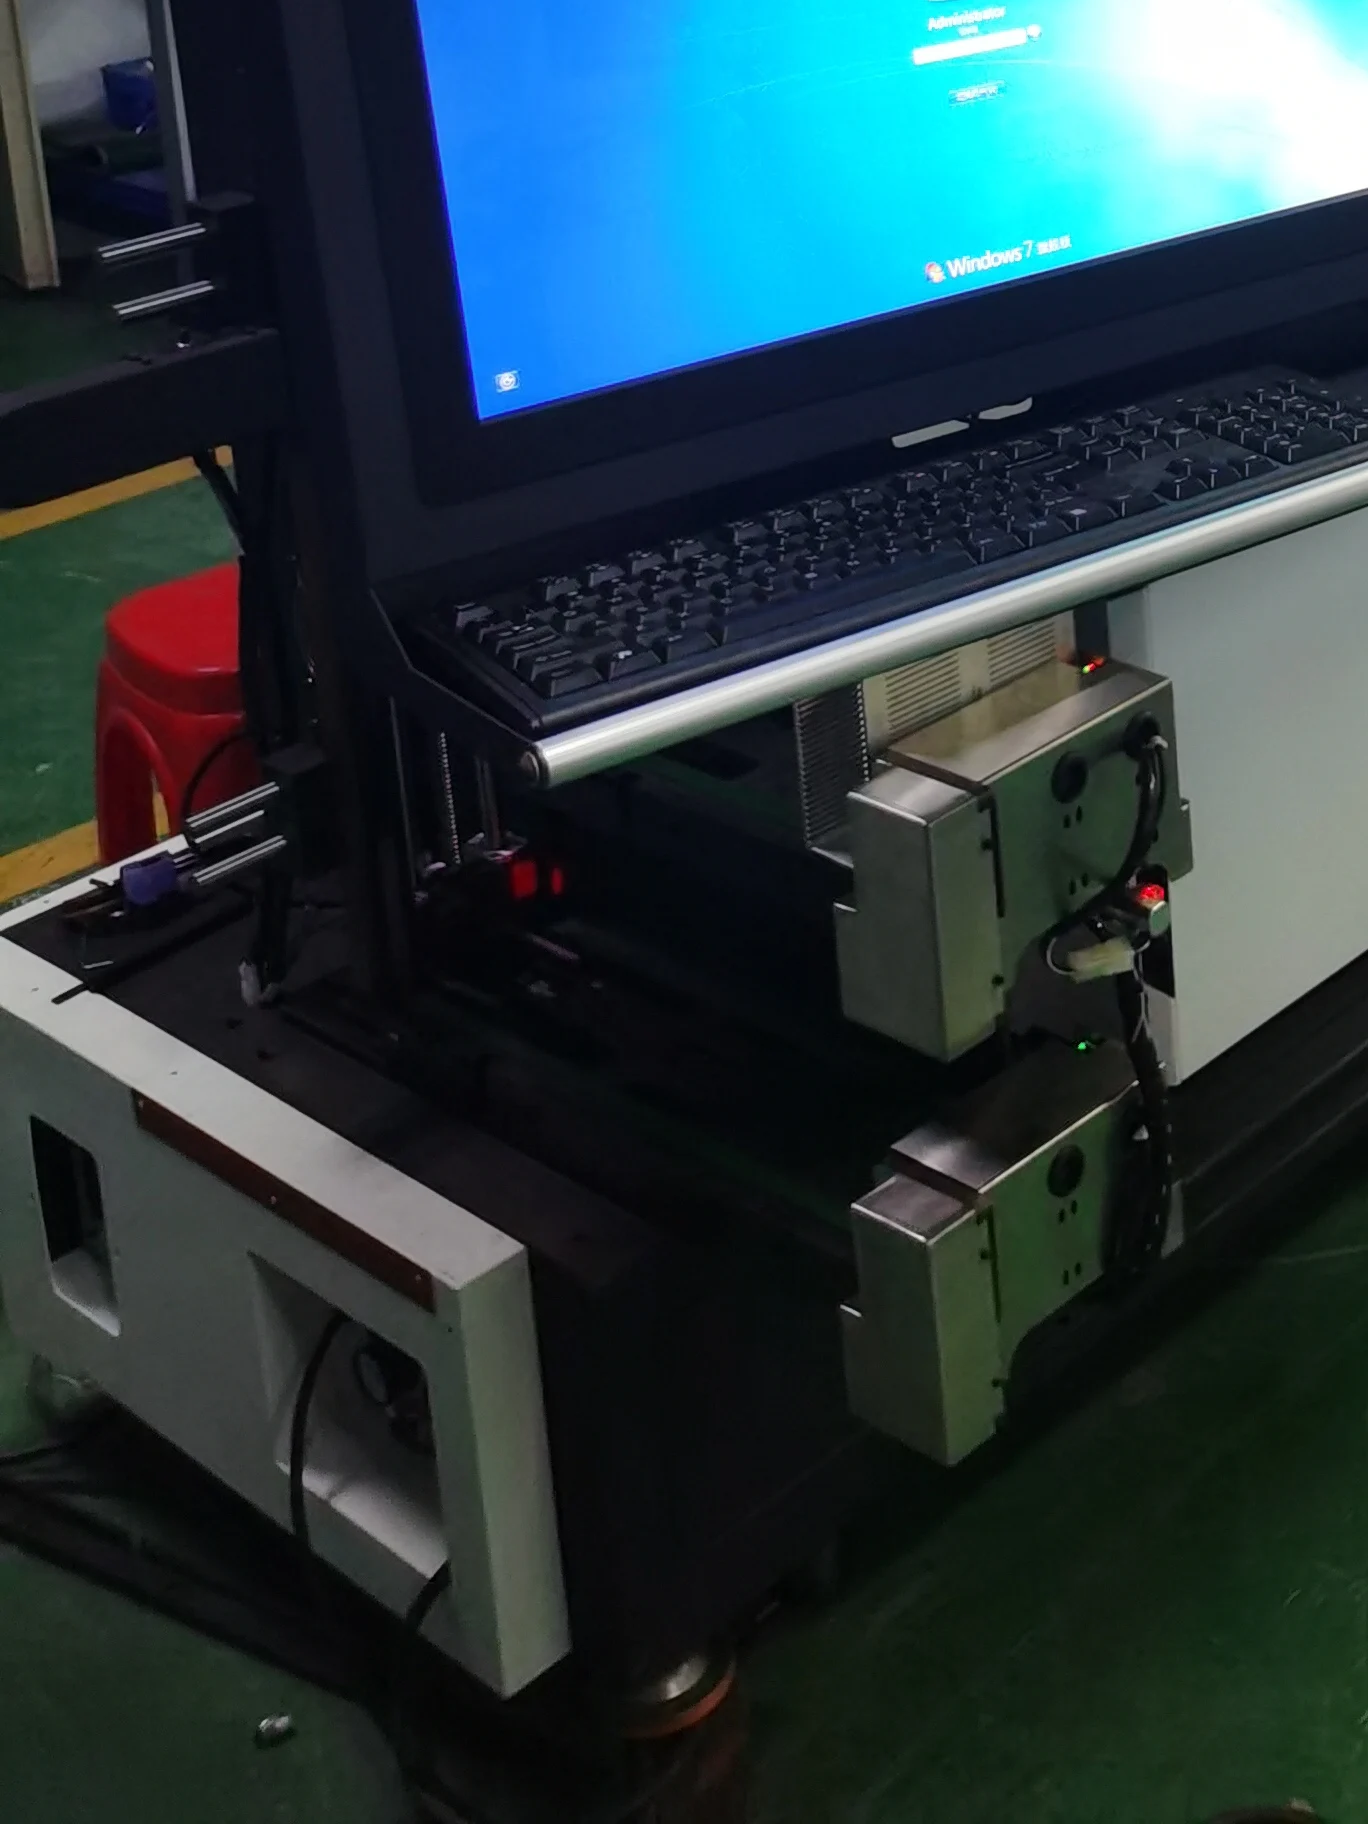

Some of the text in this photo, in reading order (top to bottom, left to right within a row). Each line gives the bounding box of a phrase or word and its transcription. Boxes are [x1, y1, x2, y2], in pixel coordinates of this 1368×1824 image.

[928, 7, 1005, 31] Administrator
[946, 248, 1022, 278] Windows
[1022, 240, 1033, 258] 7
